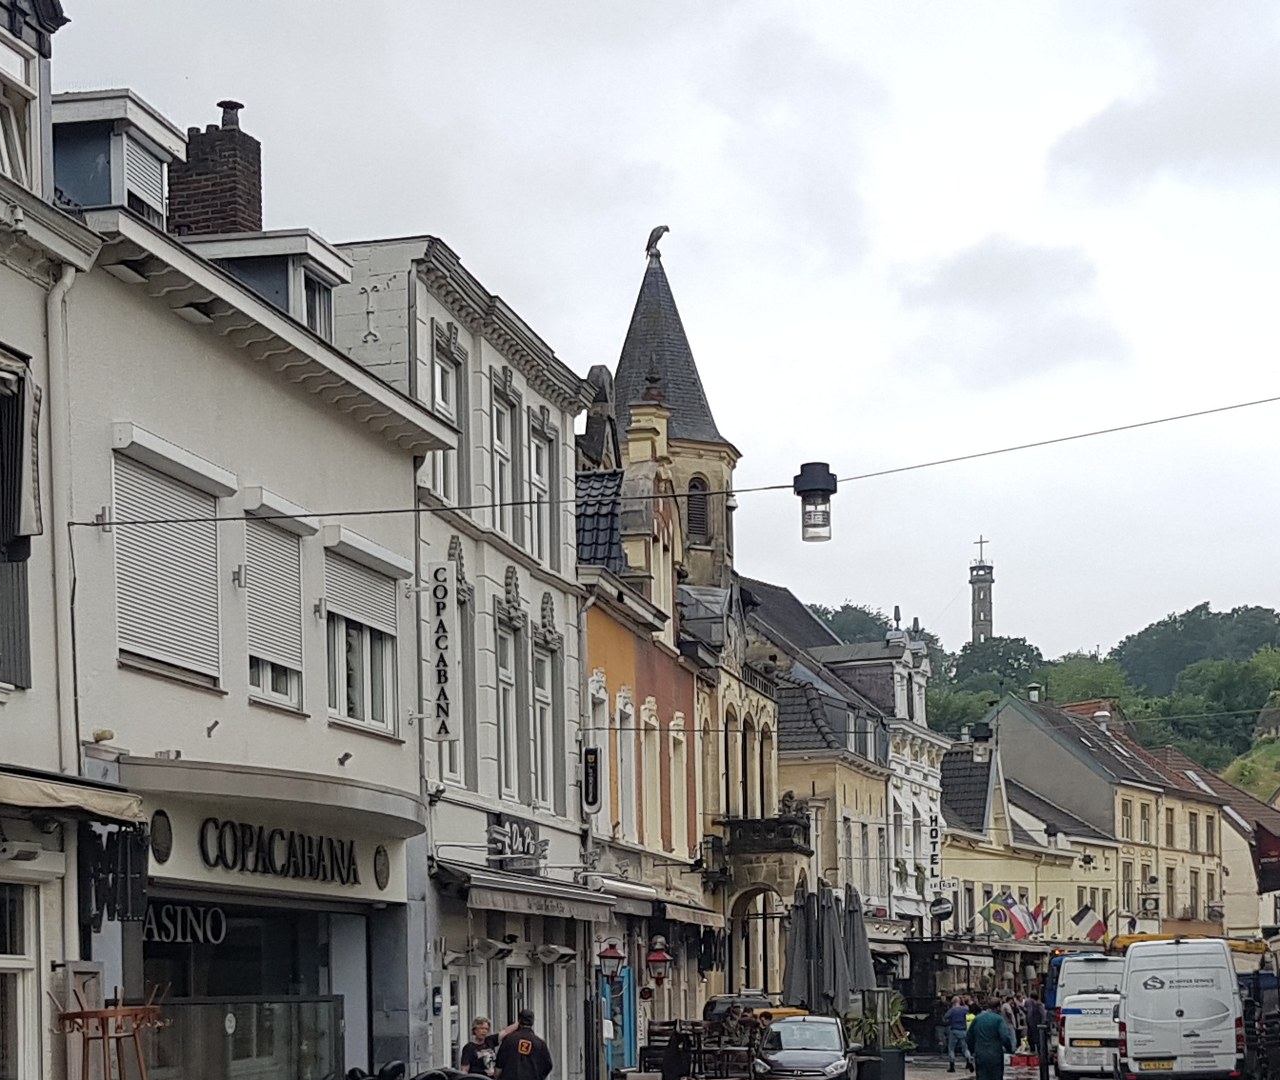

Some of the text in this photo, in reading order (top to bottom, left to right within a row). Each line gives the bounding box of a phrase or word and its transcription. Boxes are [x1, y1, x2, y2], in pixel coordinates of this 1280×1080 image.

[433, 567, 451, 735] COPACABANA
[199, 816, 362, 885] COPACABANA
[929, 815, 939, 878] HOTEL
[142, 904, 226, 943] ASINO
